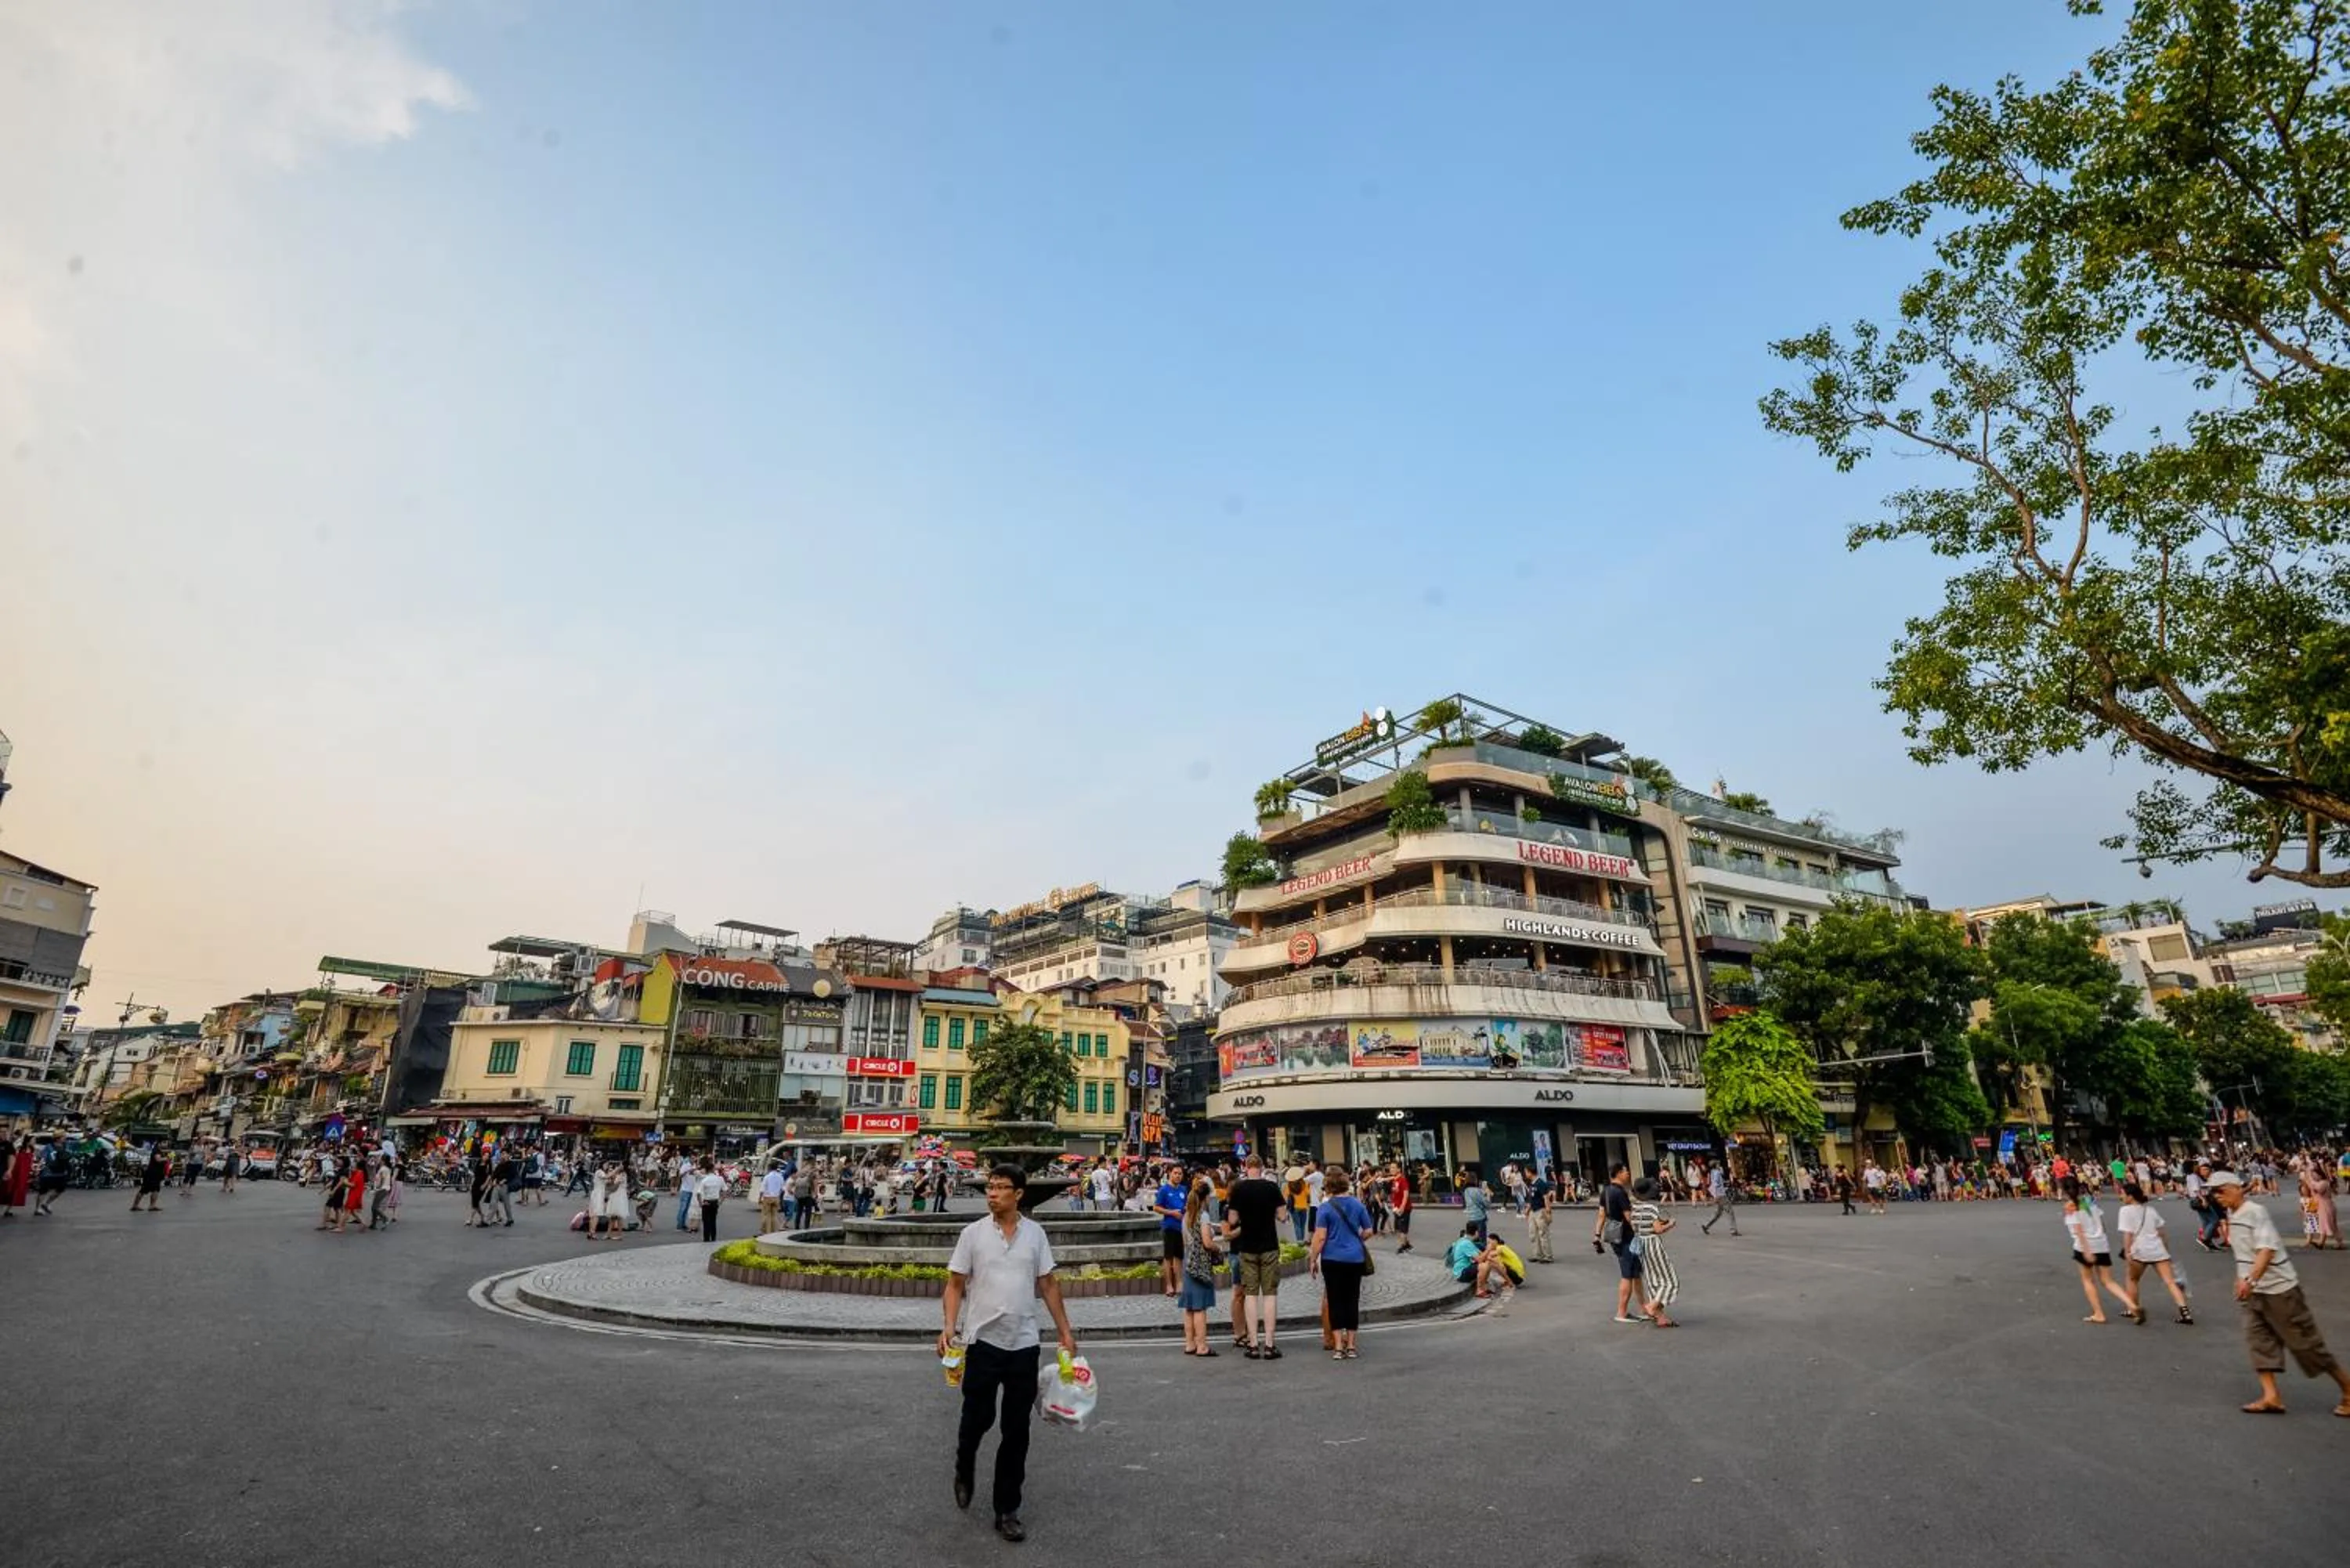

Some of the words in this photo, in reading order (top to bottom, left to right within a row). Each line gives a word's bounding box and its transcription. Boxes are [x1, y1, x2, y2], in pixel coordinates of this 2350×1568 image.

[1517, 840, 1584, 870] LEGEND
[1588, 852, 1630, 877] BEER
[1279, 869, 1333, 894] LEGEND
[1336, 855, 1372, 880] BEER
[1505, 919, 1589, 940] HIGHLANDS
[1592, 930, 1640, 945] COFFEE
[1232, 1094, 1265, 1108] ALDO
[1535, 1089, 1574, 1102] ALDO
[1509, 1152, 1531, 1161] ALDO
